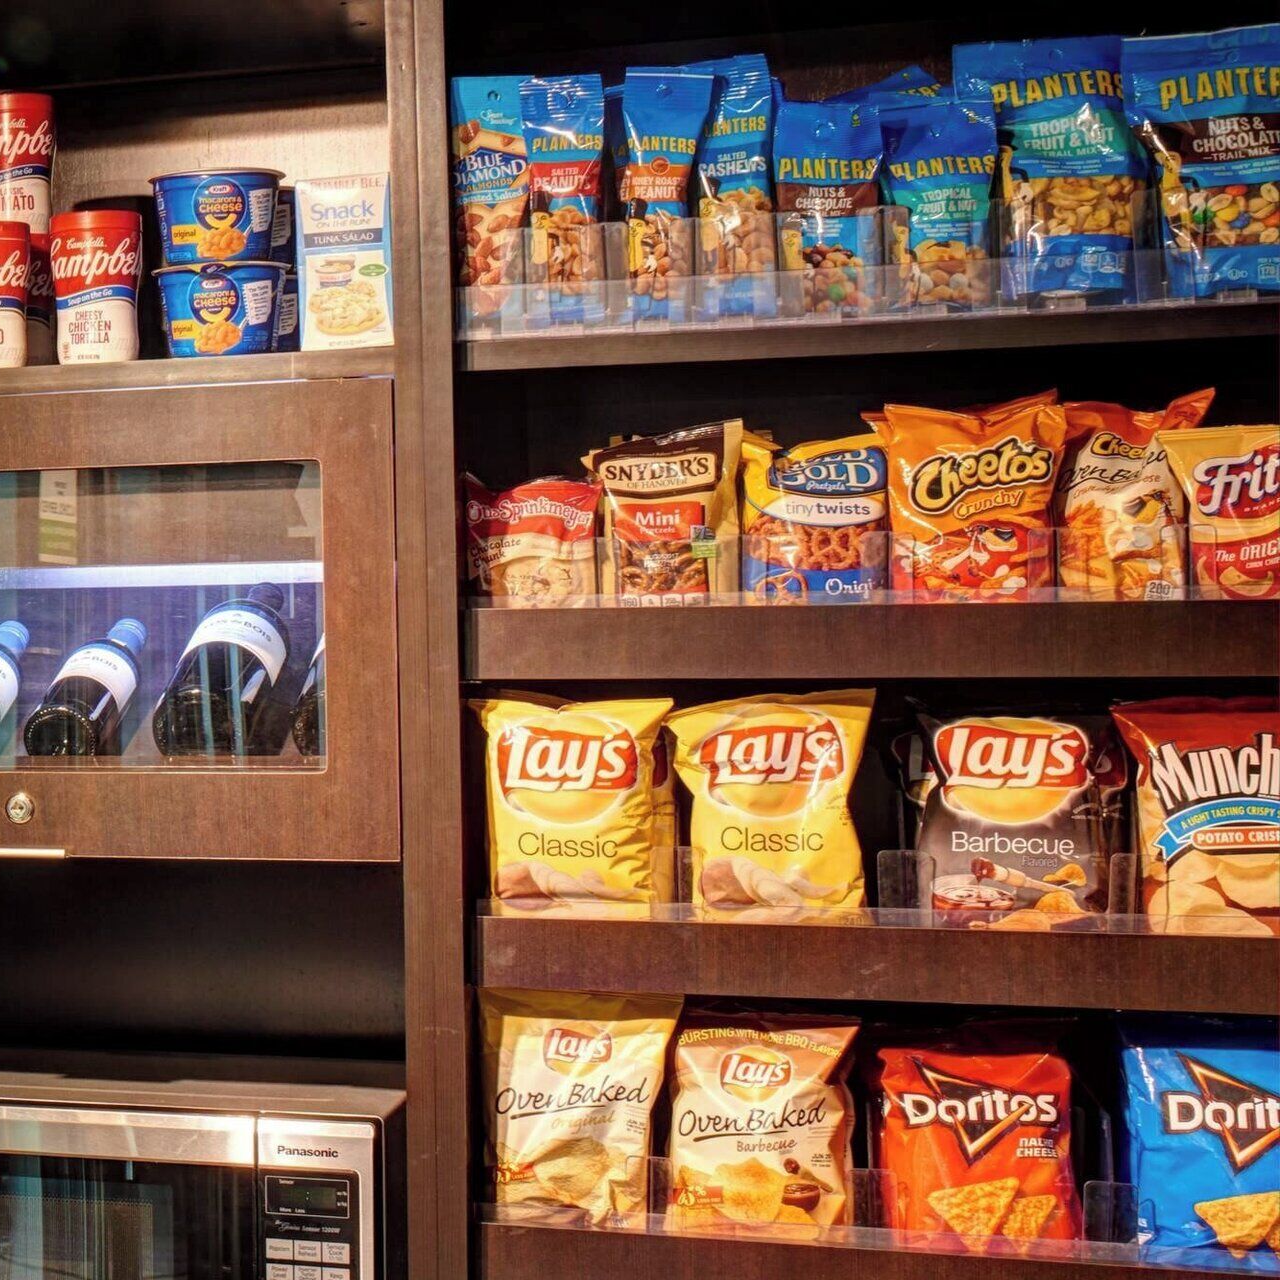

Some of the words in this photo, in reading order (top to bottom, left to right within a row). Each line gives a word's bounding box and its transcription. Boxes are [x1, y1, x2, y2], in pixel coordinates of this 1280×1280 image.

[991, 69, 1124, 112] PLANTERS
[532, 134, 604, 153] PLANTERS
[627, 137, 697, 154] PLANTERS
[1211, 150, 1247, 161] TRAIL
[1248, 146, 1271, 157] MIX
[466, 150, 504, 172] BLUE
[698, 155, 767, 177] CASHEWS
[716, 150, 747, 163] SALTED
[889, 153, 997, 182] PLANTERS
[778, 157, 880, 180] PLANTERS
[310, 201, 375, 222] Snack
[312, 234, 342, 245] TUNA
[342, 232, 375, 243] SALAD
[604, 456, 710, 482] SNYDER'S
[779, 461, 879, 489] GOLD
[912, 437, 1053, 515] Cheetos
[785, 502, 815, 516] tiny
[815, 502, 871, 516] twists
[954, 487, 1025, 519] Crunchy
[635, 509, 681, 526] Mini
[470, 538, 522, 556] Chocolate
[1215, 549, 1236, 562] The
[1148, 581, 1170, 595] 200
[505, 725, 630, 791] Lay's
[709, 723, 839, 789] Lay's
[947, 727, 1080, 789] Lay's
[1189, 813, 1211, 828] LIGHT
[1211, 805, 1246, 821] TASTING
[1246, 806, 1276, 817] CRISPY
[518, 830, 619, 859] Classic
[720, 825, 824, 854] Classic
[951, 830, 1075, 857] Barbecue
[1197, 831, 1244, 845] POTATO
[1021, 856, 1058, 868] Flavored
[547, 1027, 612, 1062] Lay's
[723, 1053, 791, 1087] Lay's
[495, 1088, 565, 1115] Oven
[570, 1077, 650, 1105] Baked
[678, 1110, 745, 1137] Oven
[748, 1097, 827, 1130] Baked
[902, 1089, 1056, 1127] Doritos
[550, 1112, 616, 1135] Original
[277, 1145, 339, 1158] Panasonic
[736, 1138, 798, 1153] Barbecue
[1016, 1147, 1058, 1158] CHEESE
